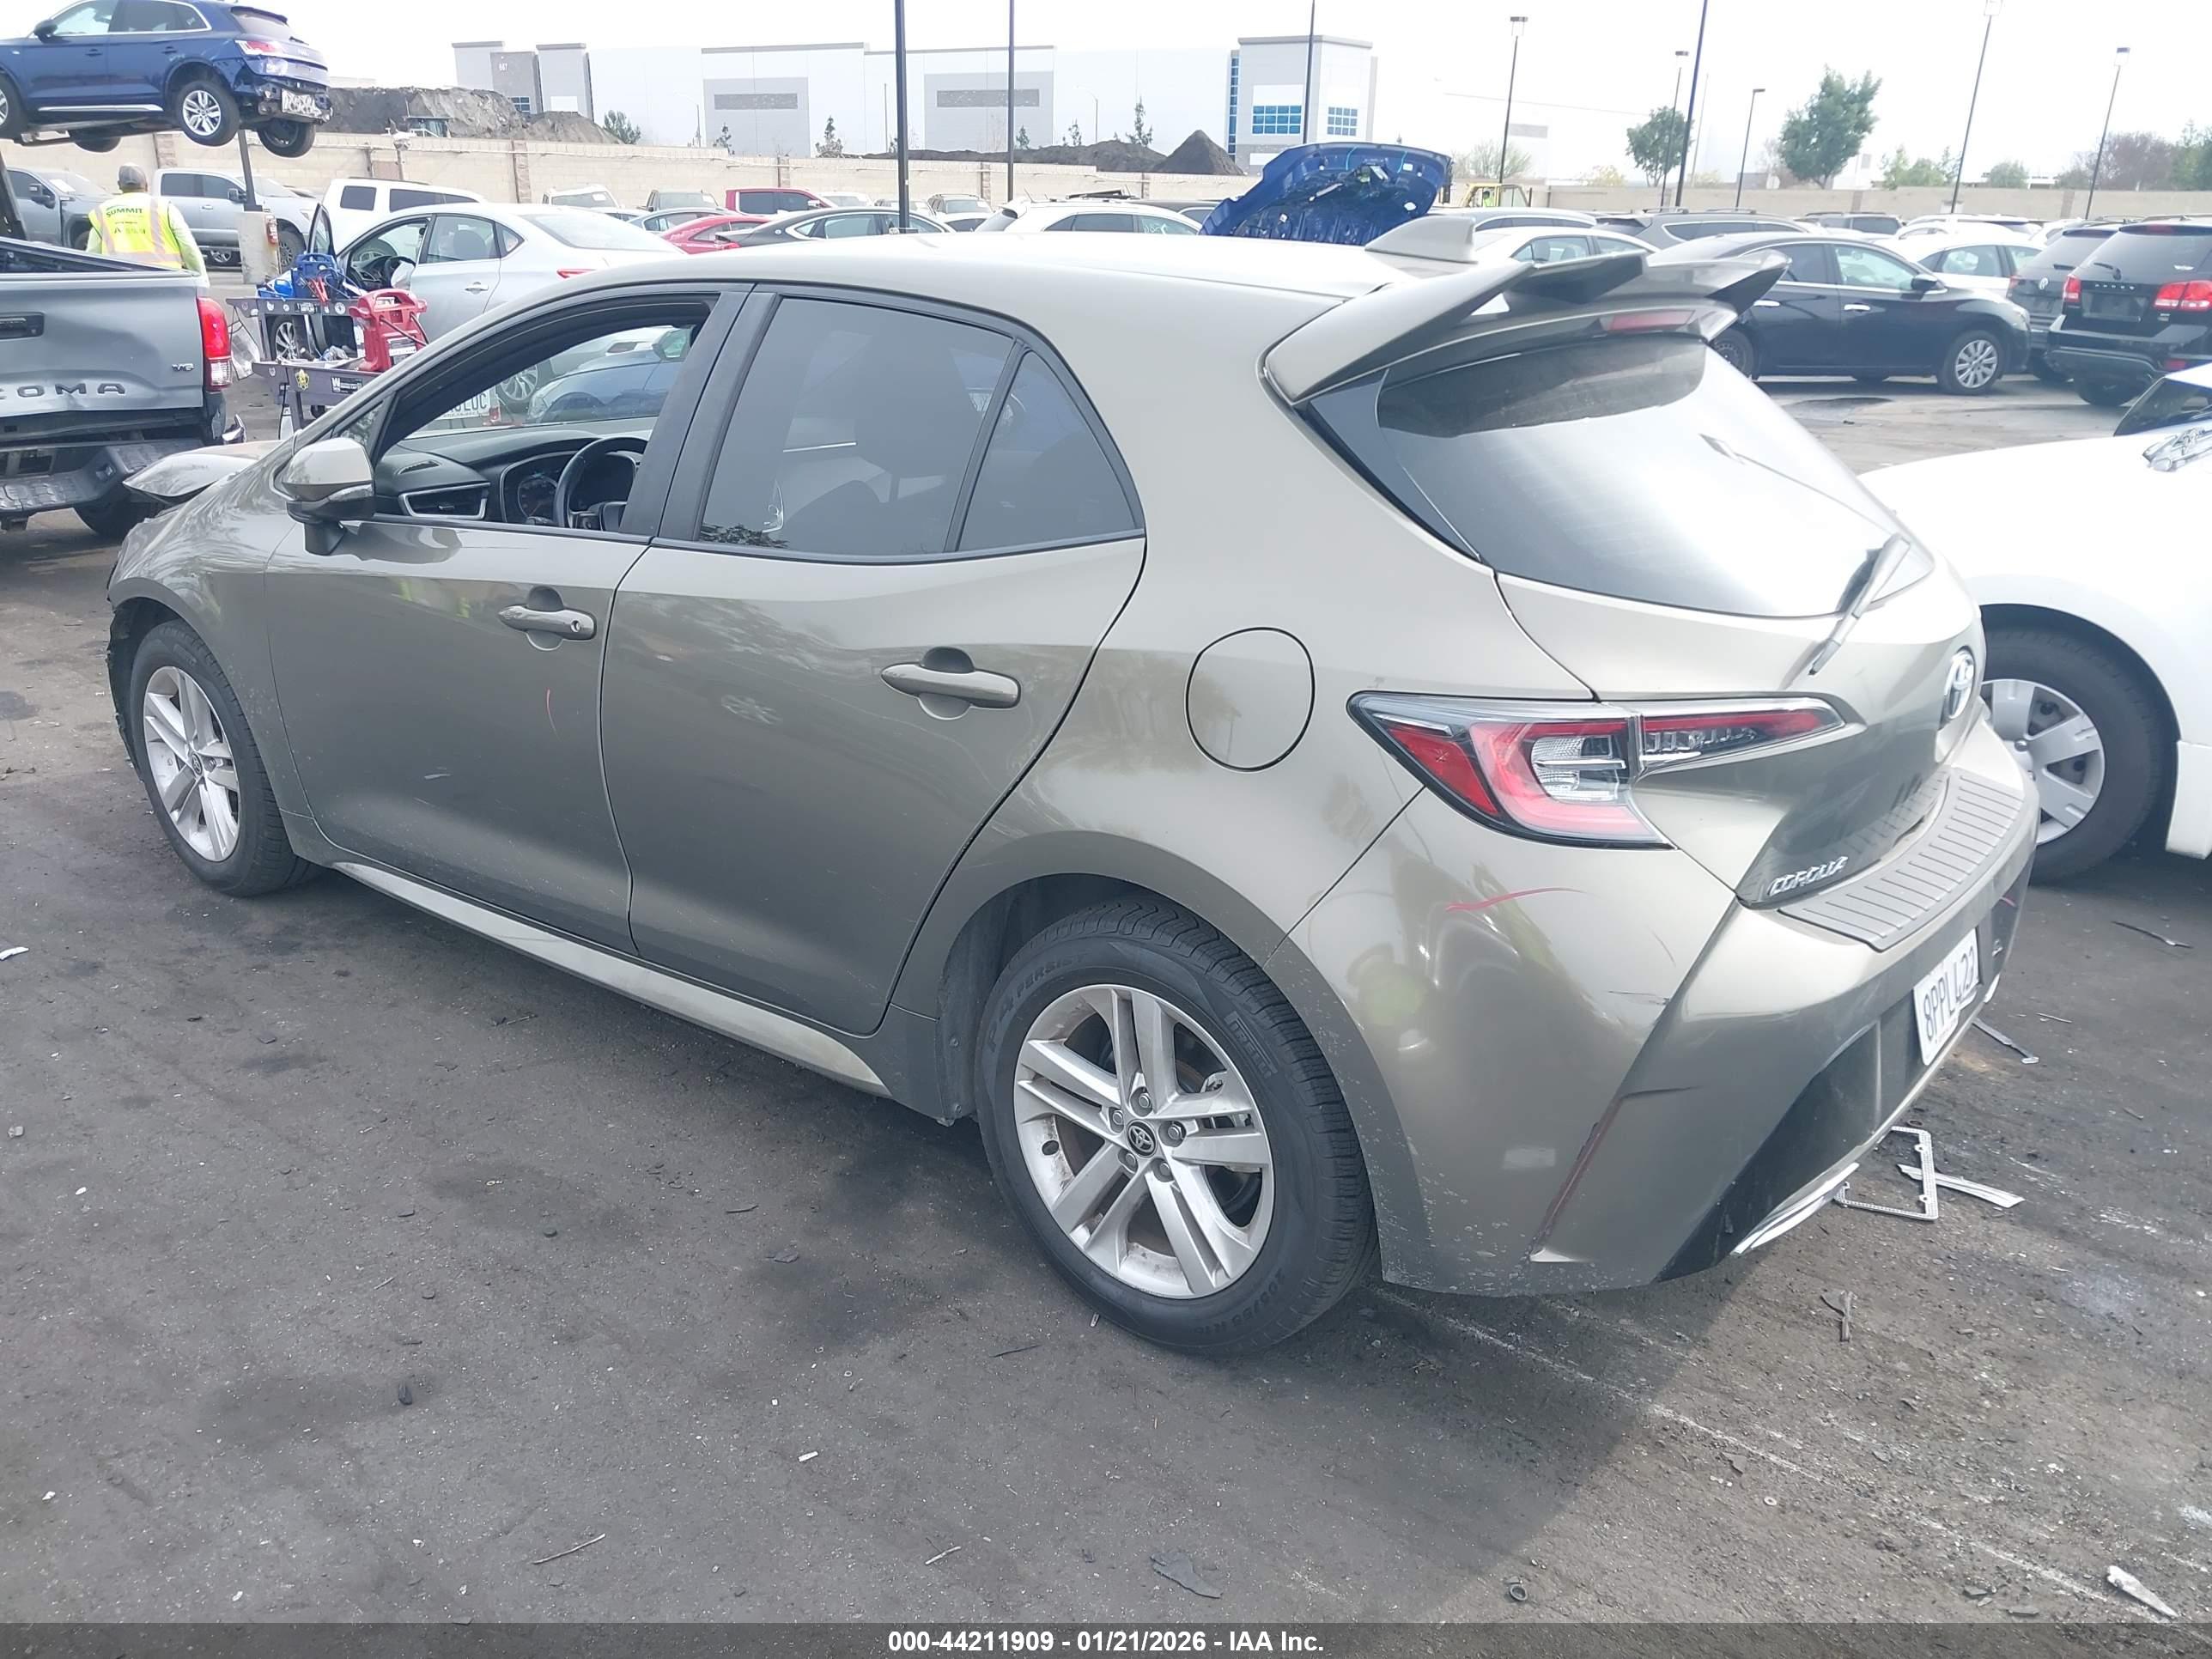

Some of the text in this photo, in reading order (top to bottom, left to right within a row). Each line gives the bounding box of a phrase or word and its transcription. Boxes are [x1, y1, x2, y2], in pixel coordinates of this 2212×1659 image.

[106, 208, 144, 218] SUMMIT
[0, 383, 125, 402] OMA
[1767, 856, 1849, 896] COROLLA
